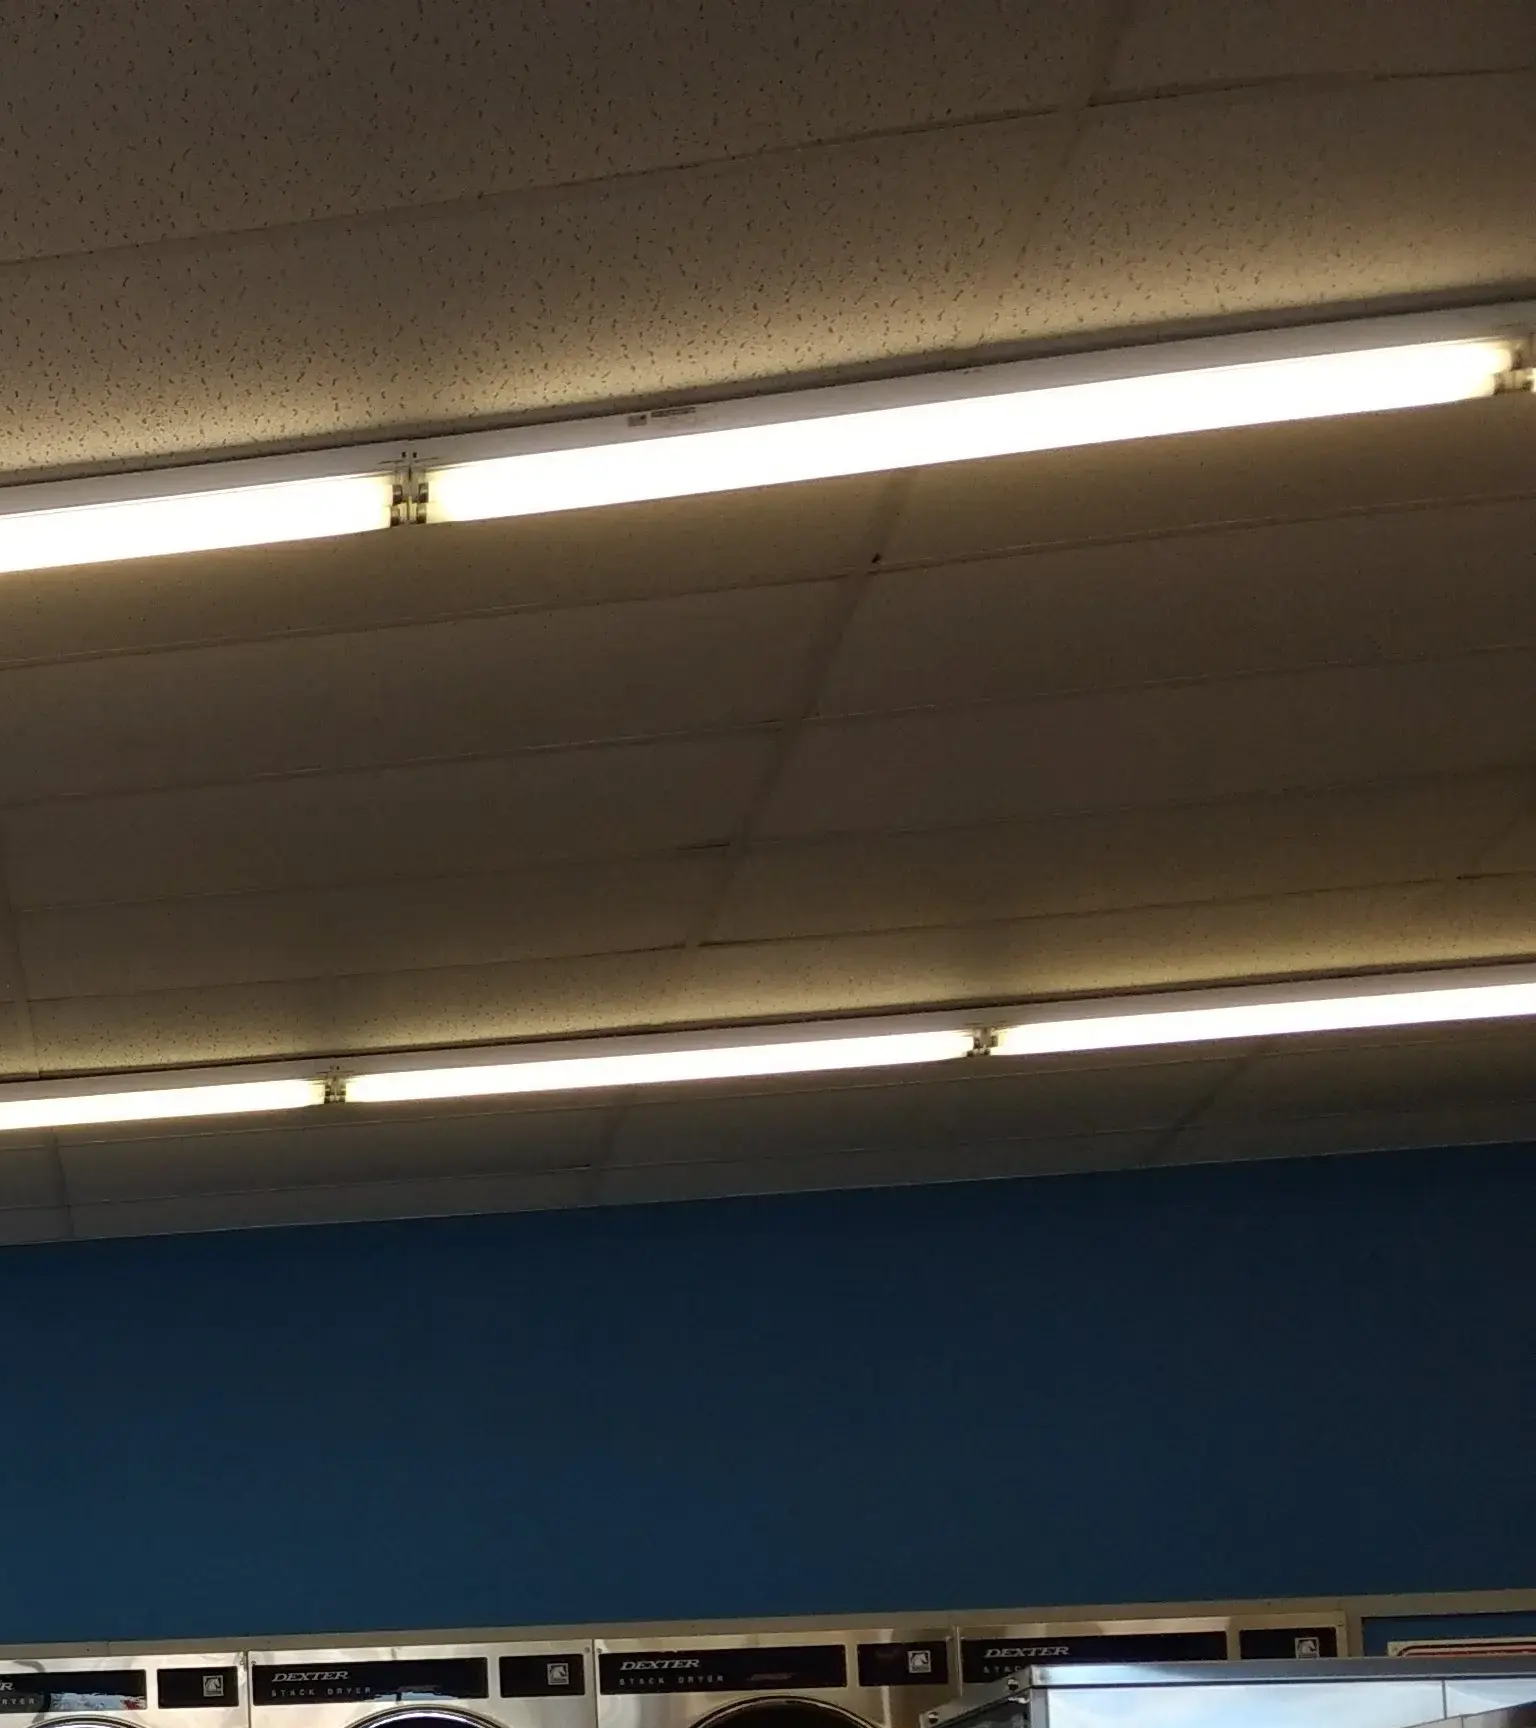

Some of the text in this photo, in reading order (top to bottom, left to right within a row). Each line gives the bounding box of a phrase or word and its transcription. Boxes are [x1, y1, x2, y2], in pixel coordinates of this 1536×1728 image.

[983, 1646, 1071, 1659] DEXTER
[619, 1658, 702, 1671] DEXTER
[982, 1664, 1025, 1675] STAC
[271, 1670, 351, 1683] DEXTER
[618, 1674, 725, 1686] STACK DRYER
[271, 1686, 372, 1698] STACK DRYER
